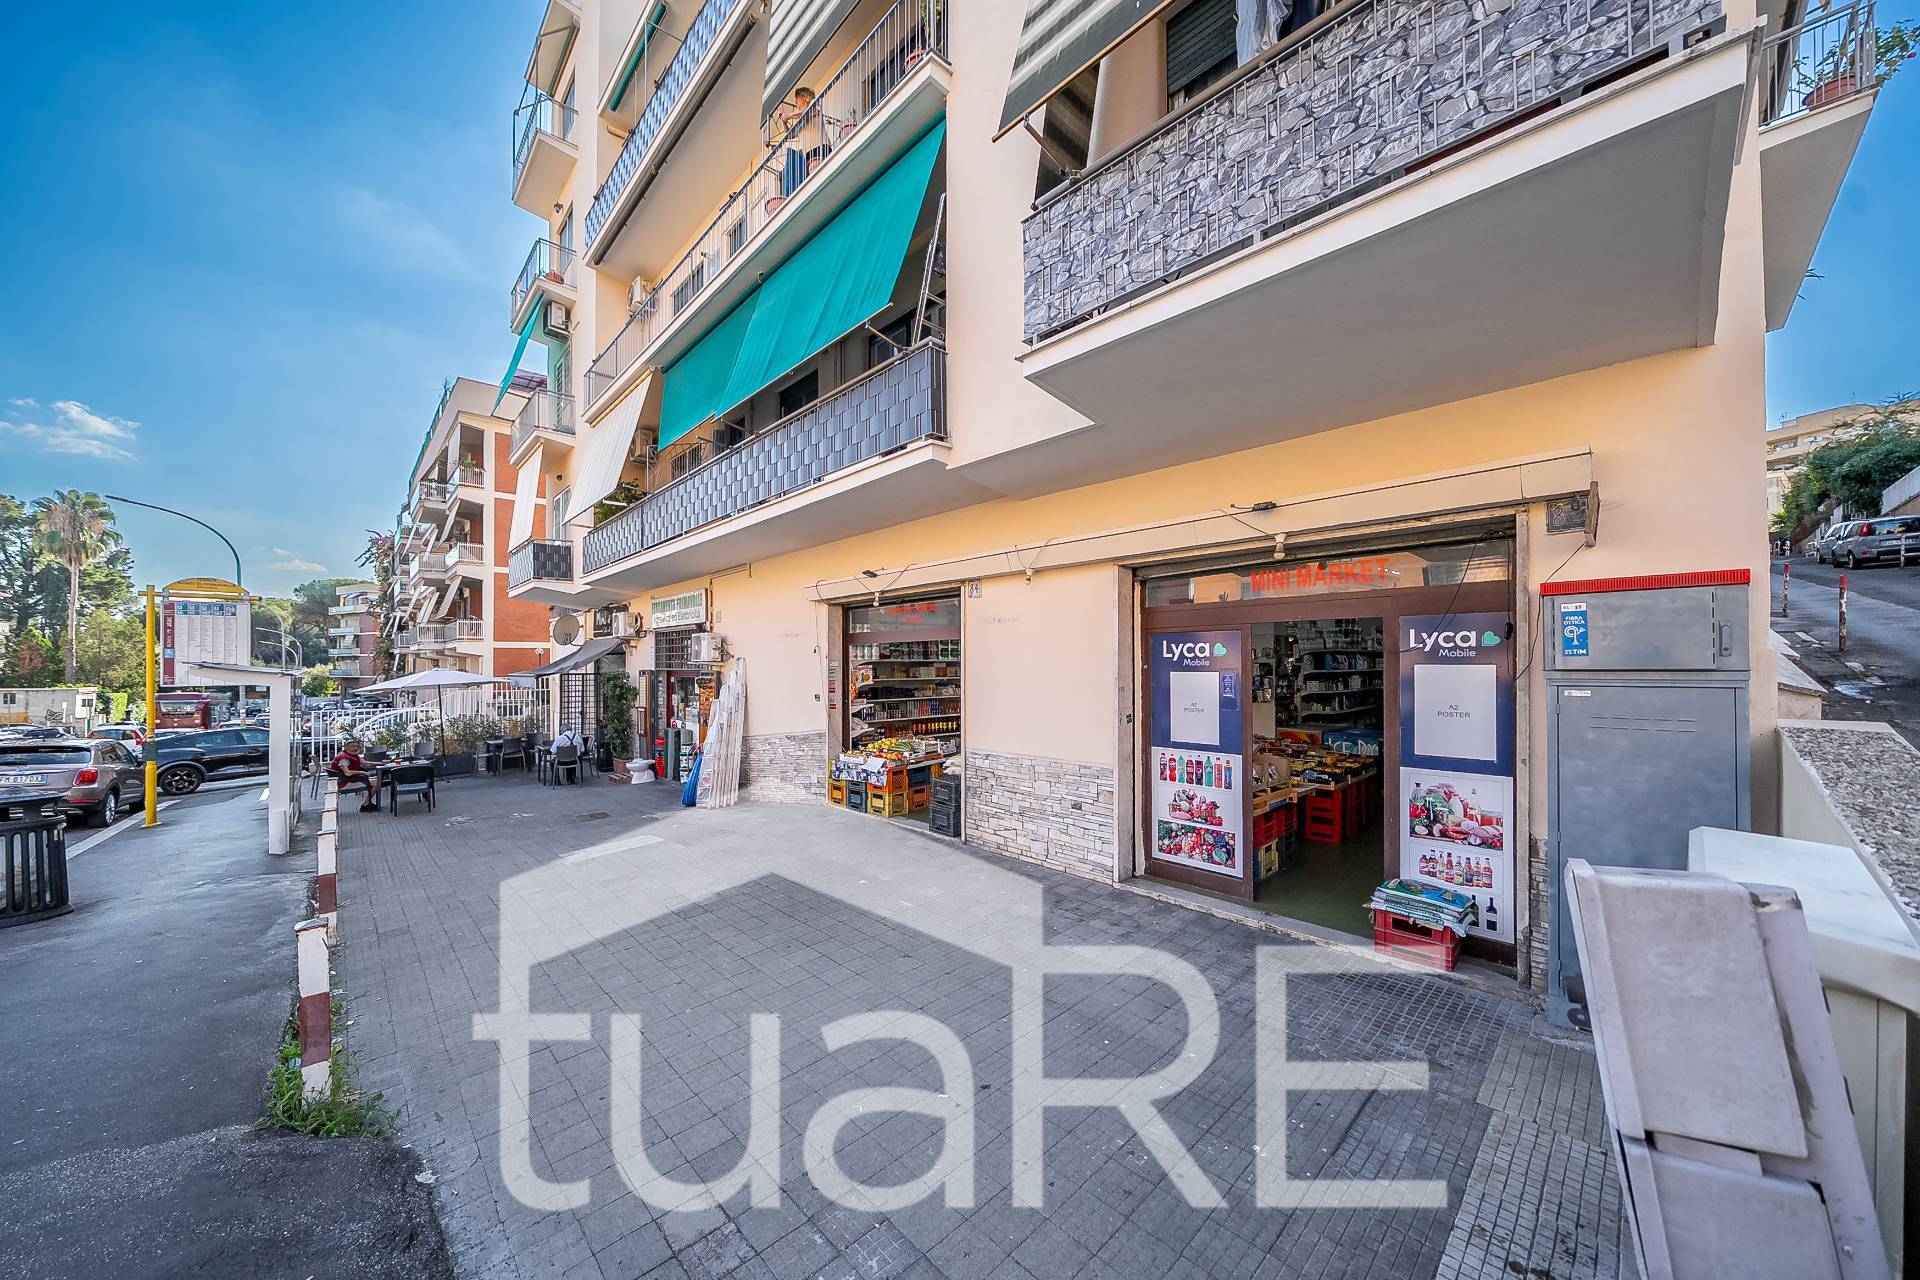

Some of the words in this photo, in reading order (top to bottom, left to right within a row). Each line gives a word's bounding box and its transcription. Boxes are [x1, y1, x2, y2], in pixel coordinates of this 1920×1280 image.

[1250, 568, 1291, 593] MINI
[1296, 557, 1390, 588] MARKET
[1409, 628, 1477, 652] Lyca
[1162, 640, 1210, 661] Lyca
[1439, 648, 1477, 657] Mobile
[1183, 658, 1210, 667] Mobile
[1437, 711, 1471, 719] POSTER
